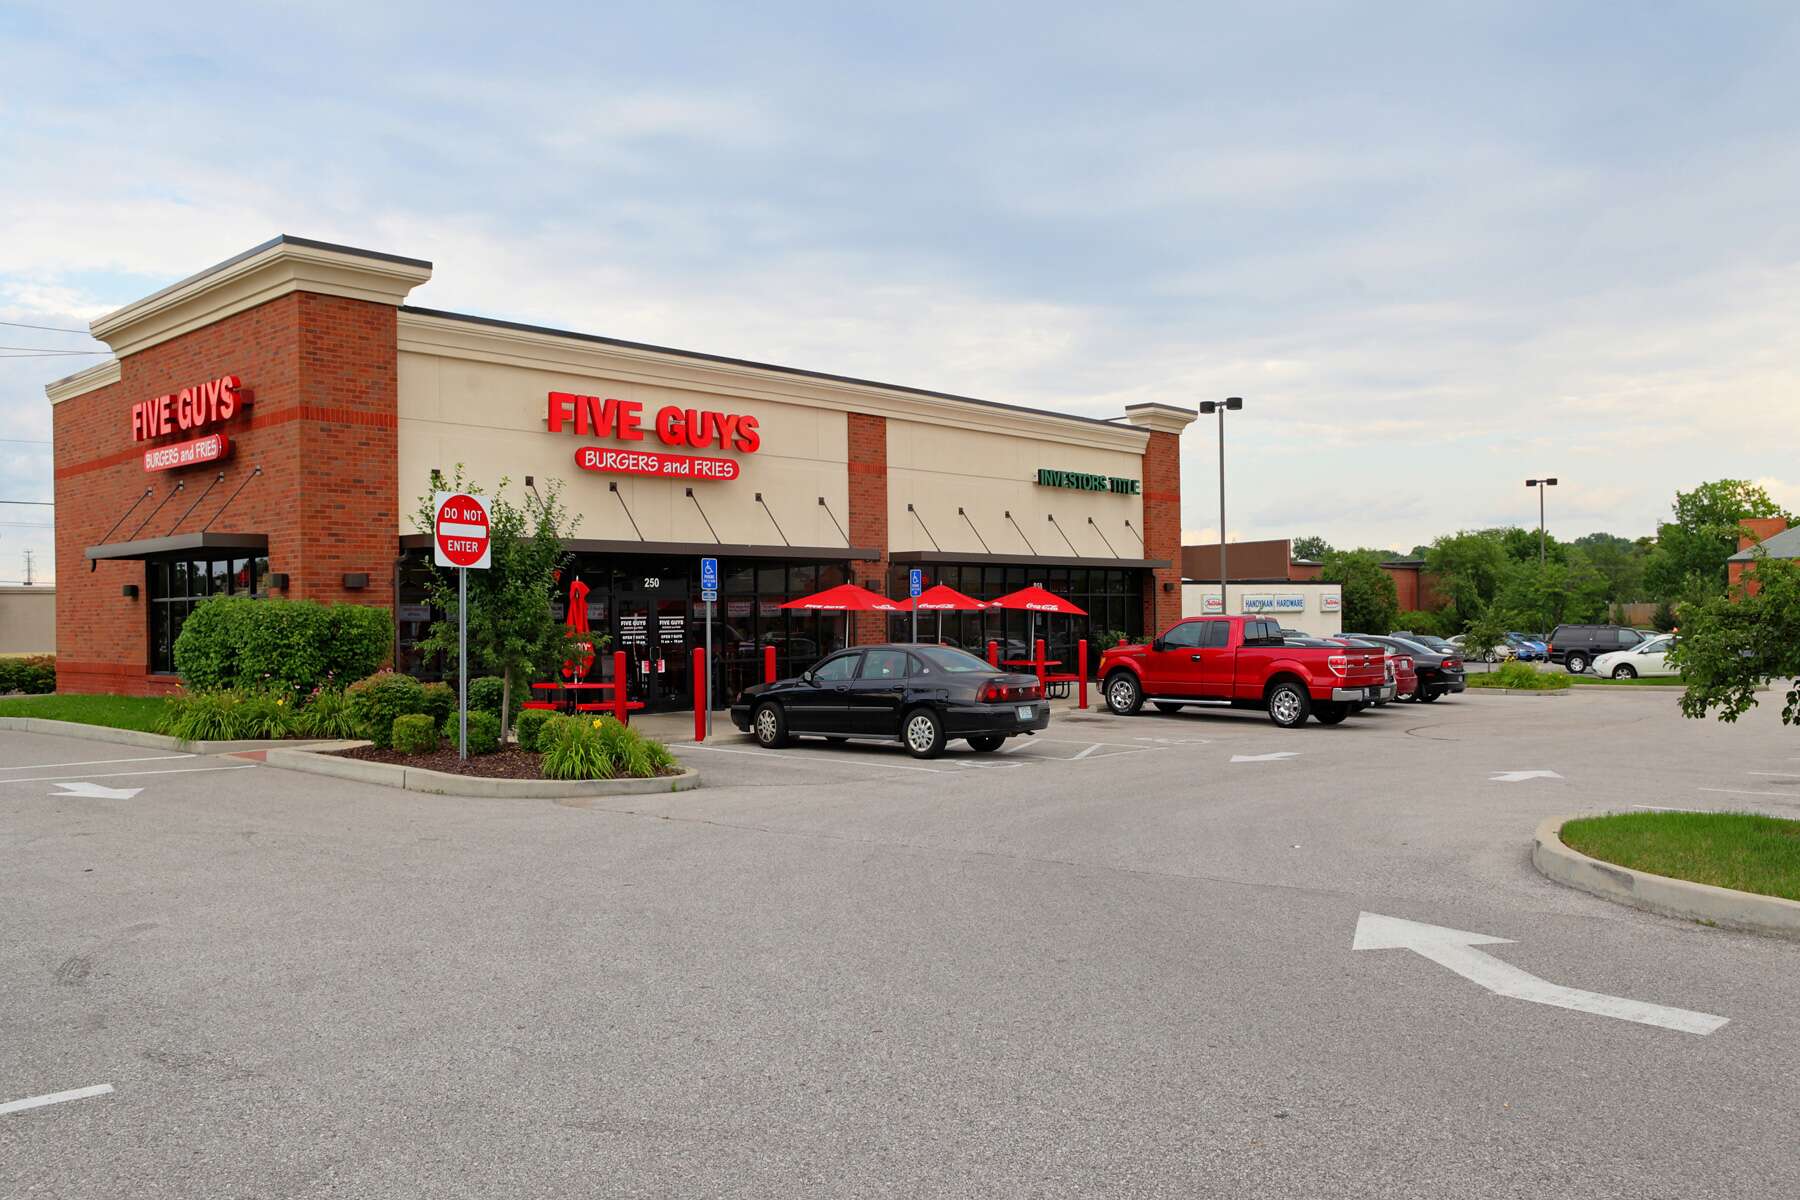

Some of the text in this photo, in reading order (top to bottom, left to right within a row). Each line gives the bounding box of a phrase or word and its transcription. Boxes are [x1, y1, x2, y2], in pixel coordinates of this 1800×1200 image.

[132, 375, 241, 441] FIVE GUYS
[548, 391, 760, 454] FIVE GUYS
[145, 439, 217, 469] BURGERS and FRIES
[585, 450, 734, 477] BURGERS and FRIES
[1038, 469, 1140, 495] INVESTORS TITLE
[444, 507, 482, 521] DO NOT
[447, 540, 478, 552] ENTER
[644, 578, 660, 588] 250
[1276, 599, 1304, 608] HARDWARE
